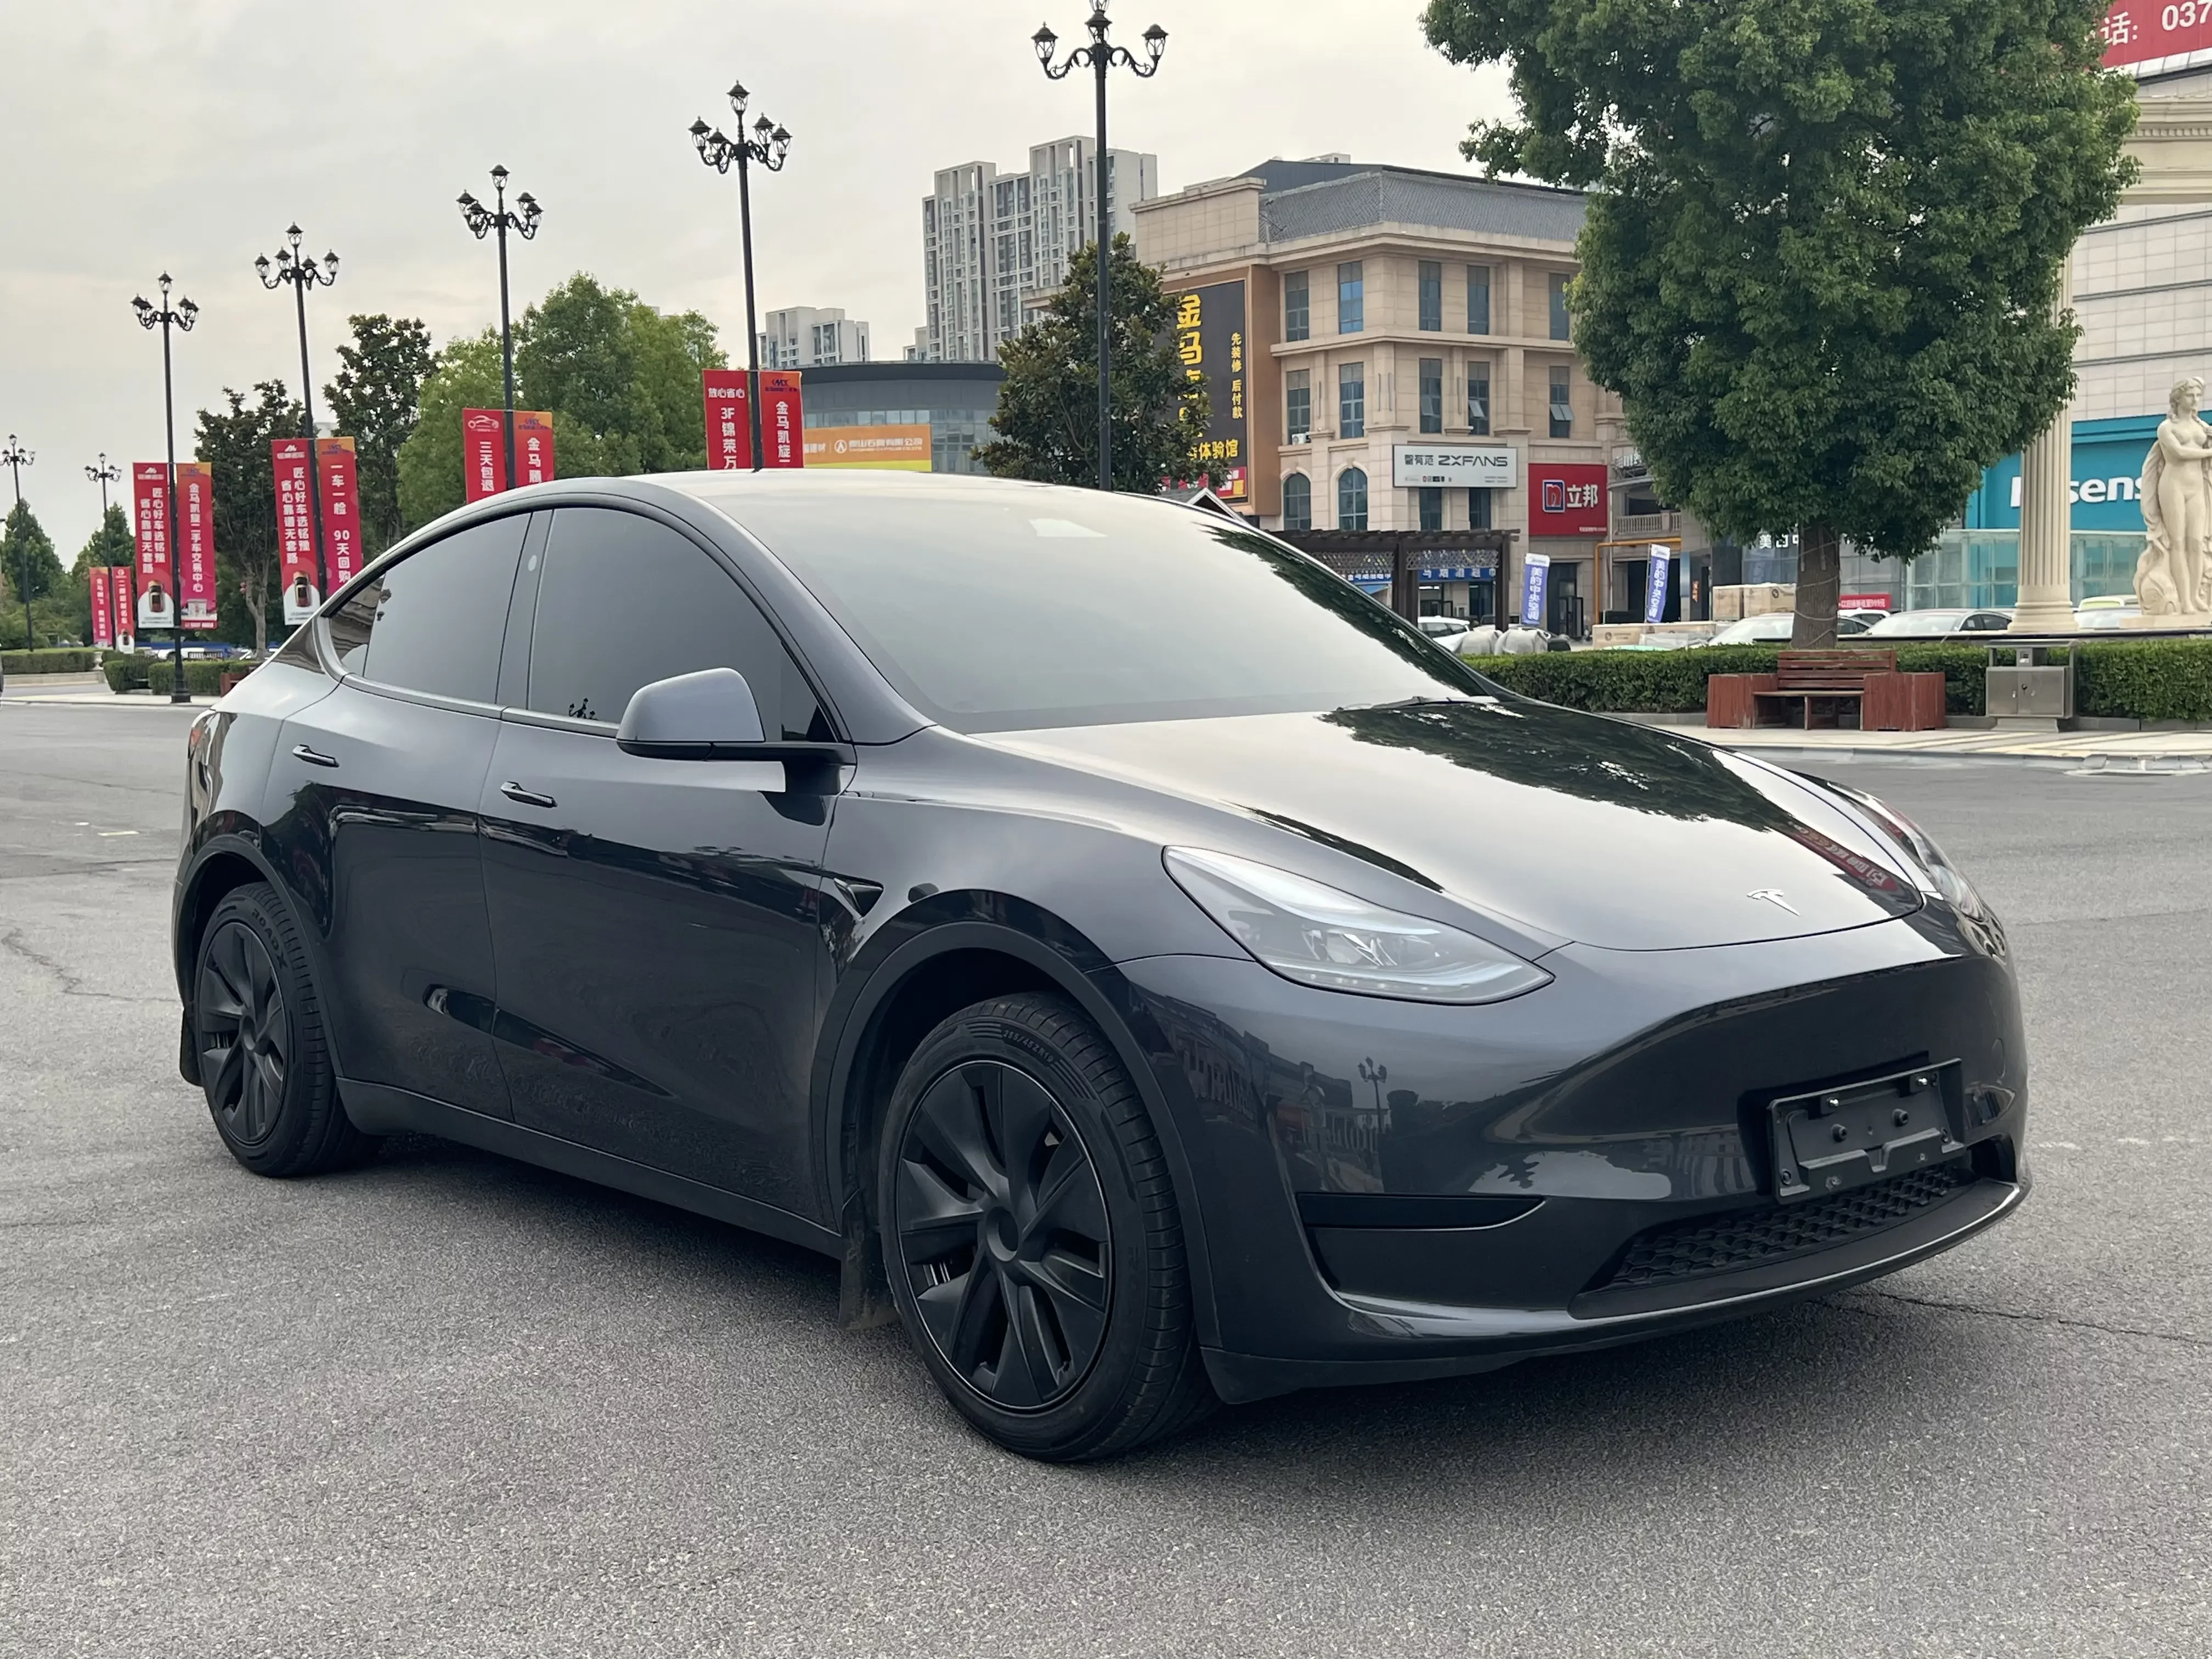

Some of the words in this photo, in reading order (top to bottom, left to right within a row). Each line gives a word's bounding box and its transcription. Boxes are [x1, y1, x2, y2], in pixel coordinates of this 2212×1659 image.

[2162, 0, 2212, 31] 037
[1231, 332, 1242, 373] 先装修
[708, 387, 745, 398] 放心省心
[1232, 379, 1243, 419] 后付款
[479, 441, 494, 492] 三天包退
[1438, 455, 1508, 467] ZXFANS
[330, 465, 347, 515] 一车一检
[1567, 483, 1598, 508] 立邦
[252, 908, 288, 969] ROADX
[1003, 1030, 1053, 1063] 255/45ZR19
